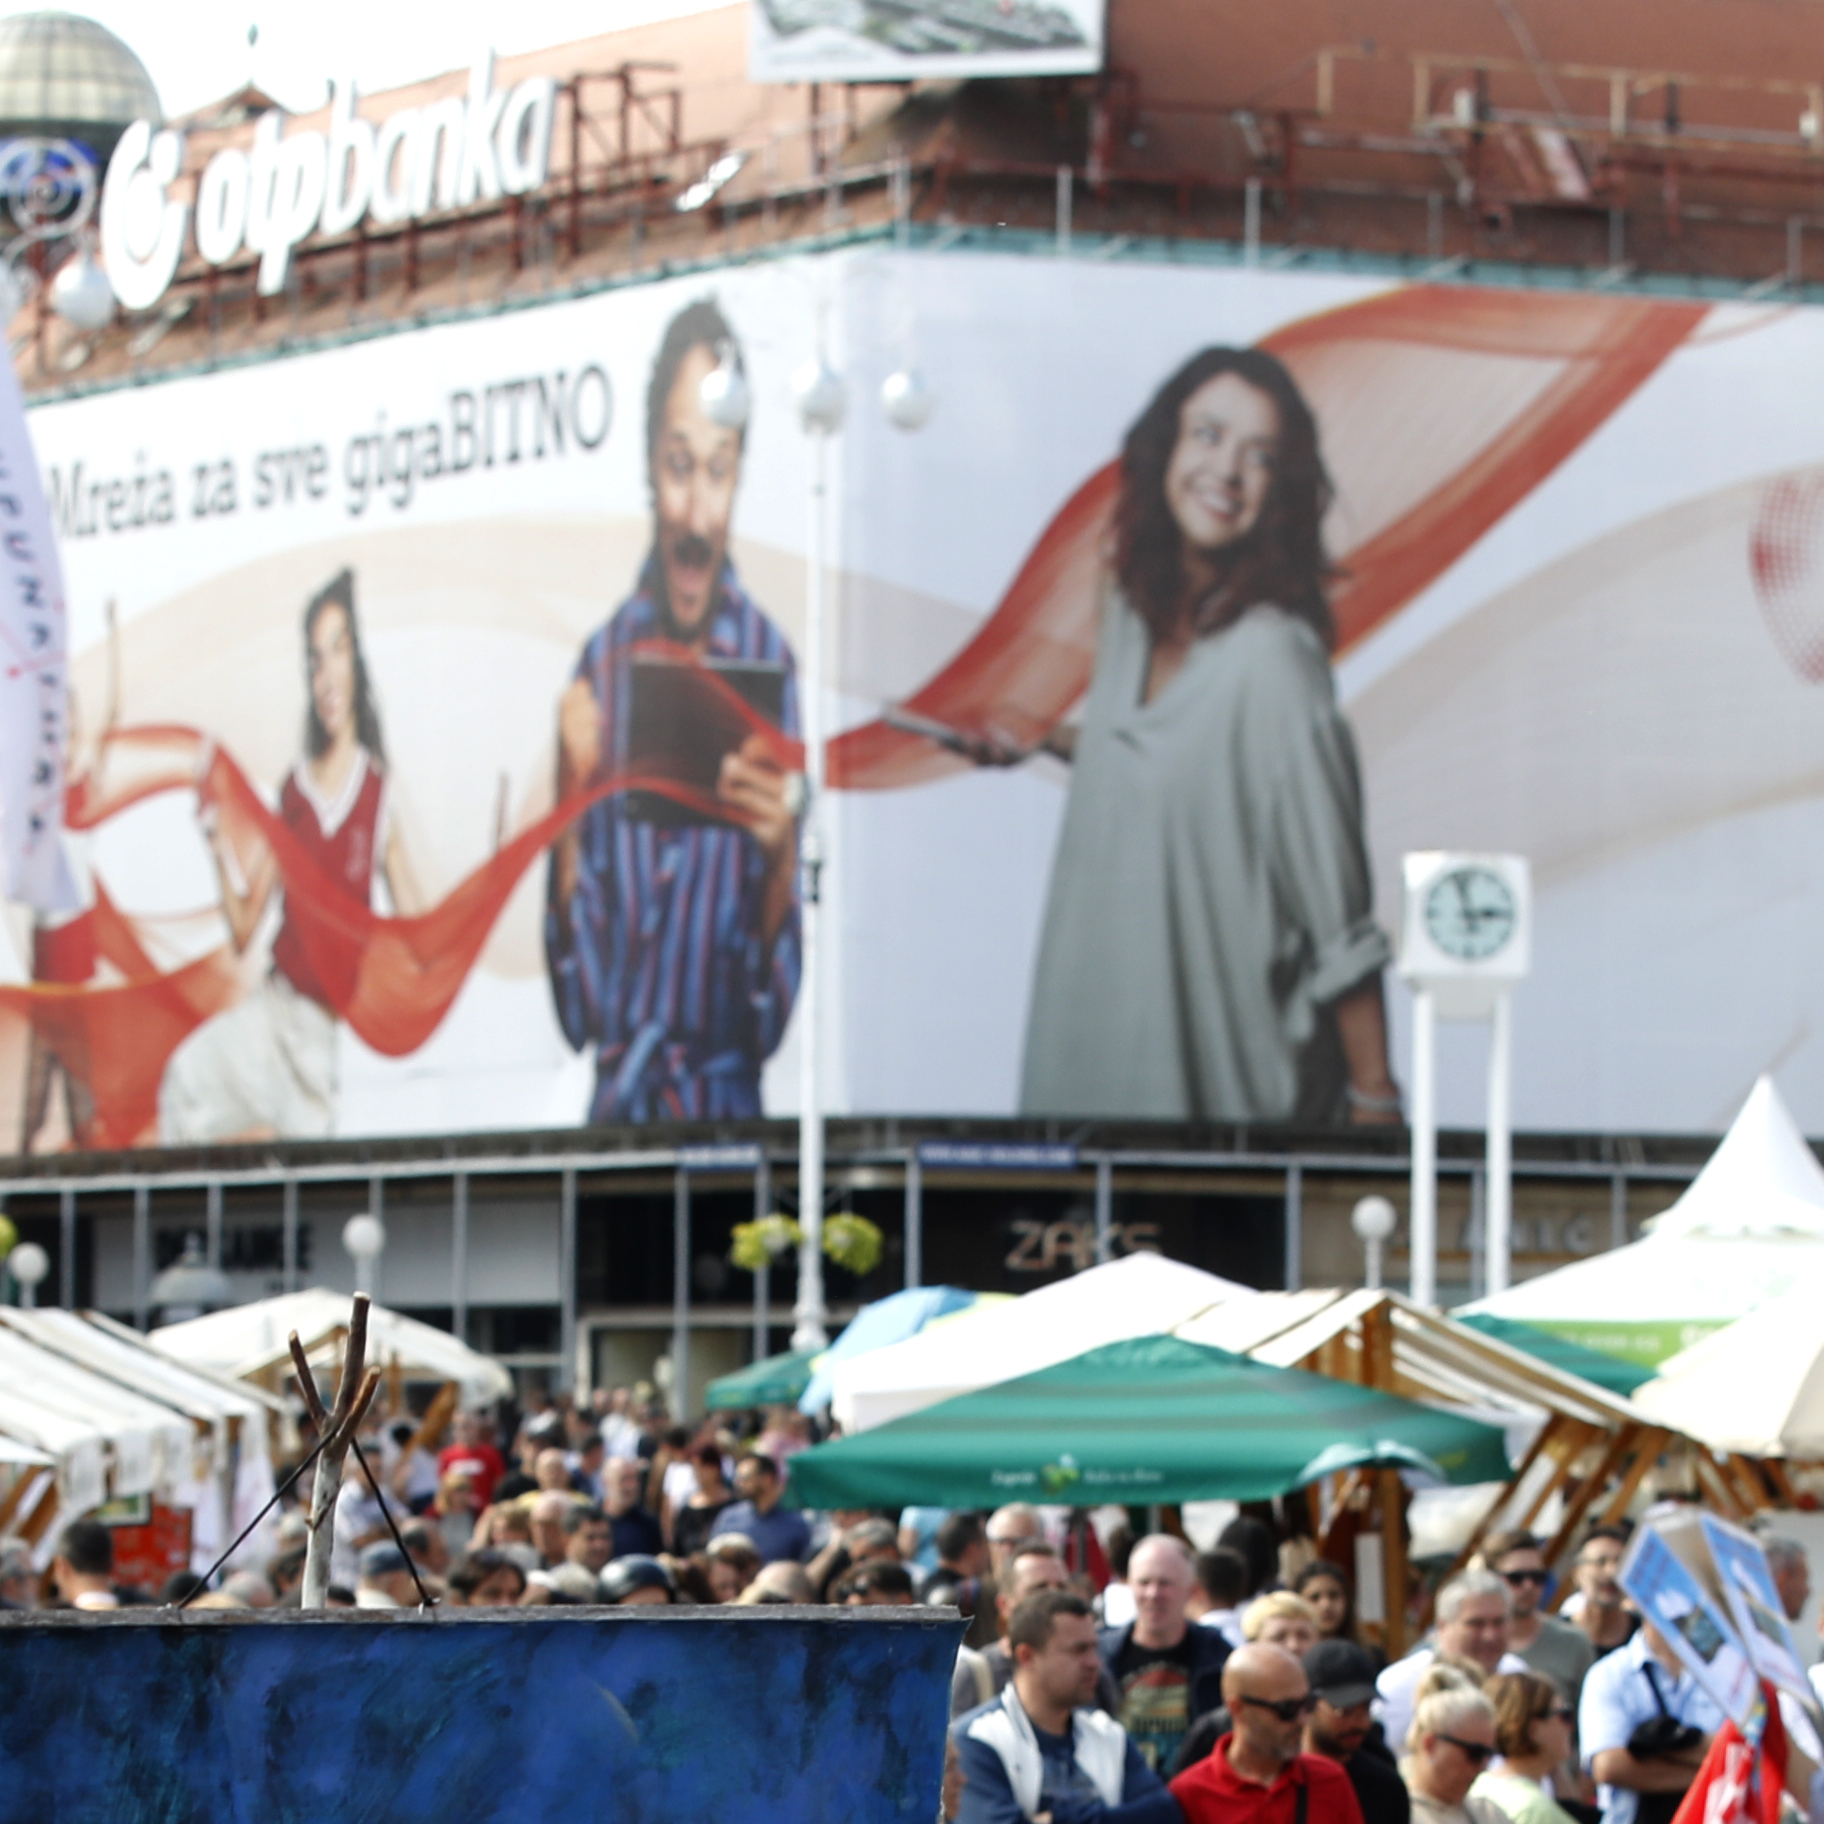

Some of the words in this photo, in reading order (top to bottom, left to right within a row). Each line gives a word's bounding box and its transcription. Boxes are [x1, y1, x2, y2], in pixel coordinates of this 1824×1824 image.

[191, 455, 237, 519] za
[252, 440, 329, 507] sve
[343, 364, 614, 515] gigaBITNO
